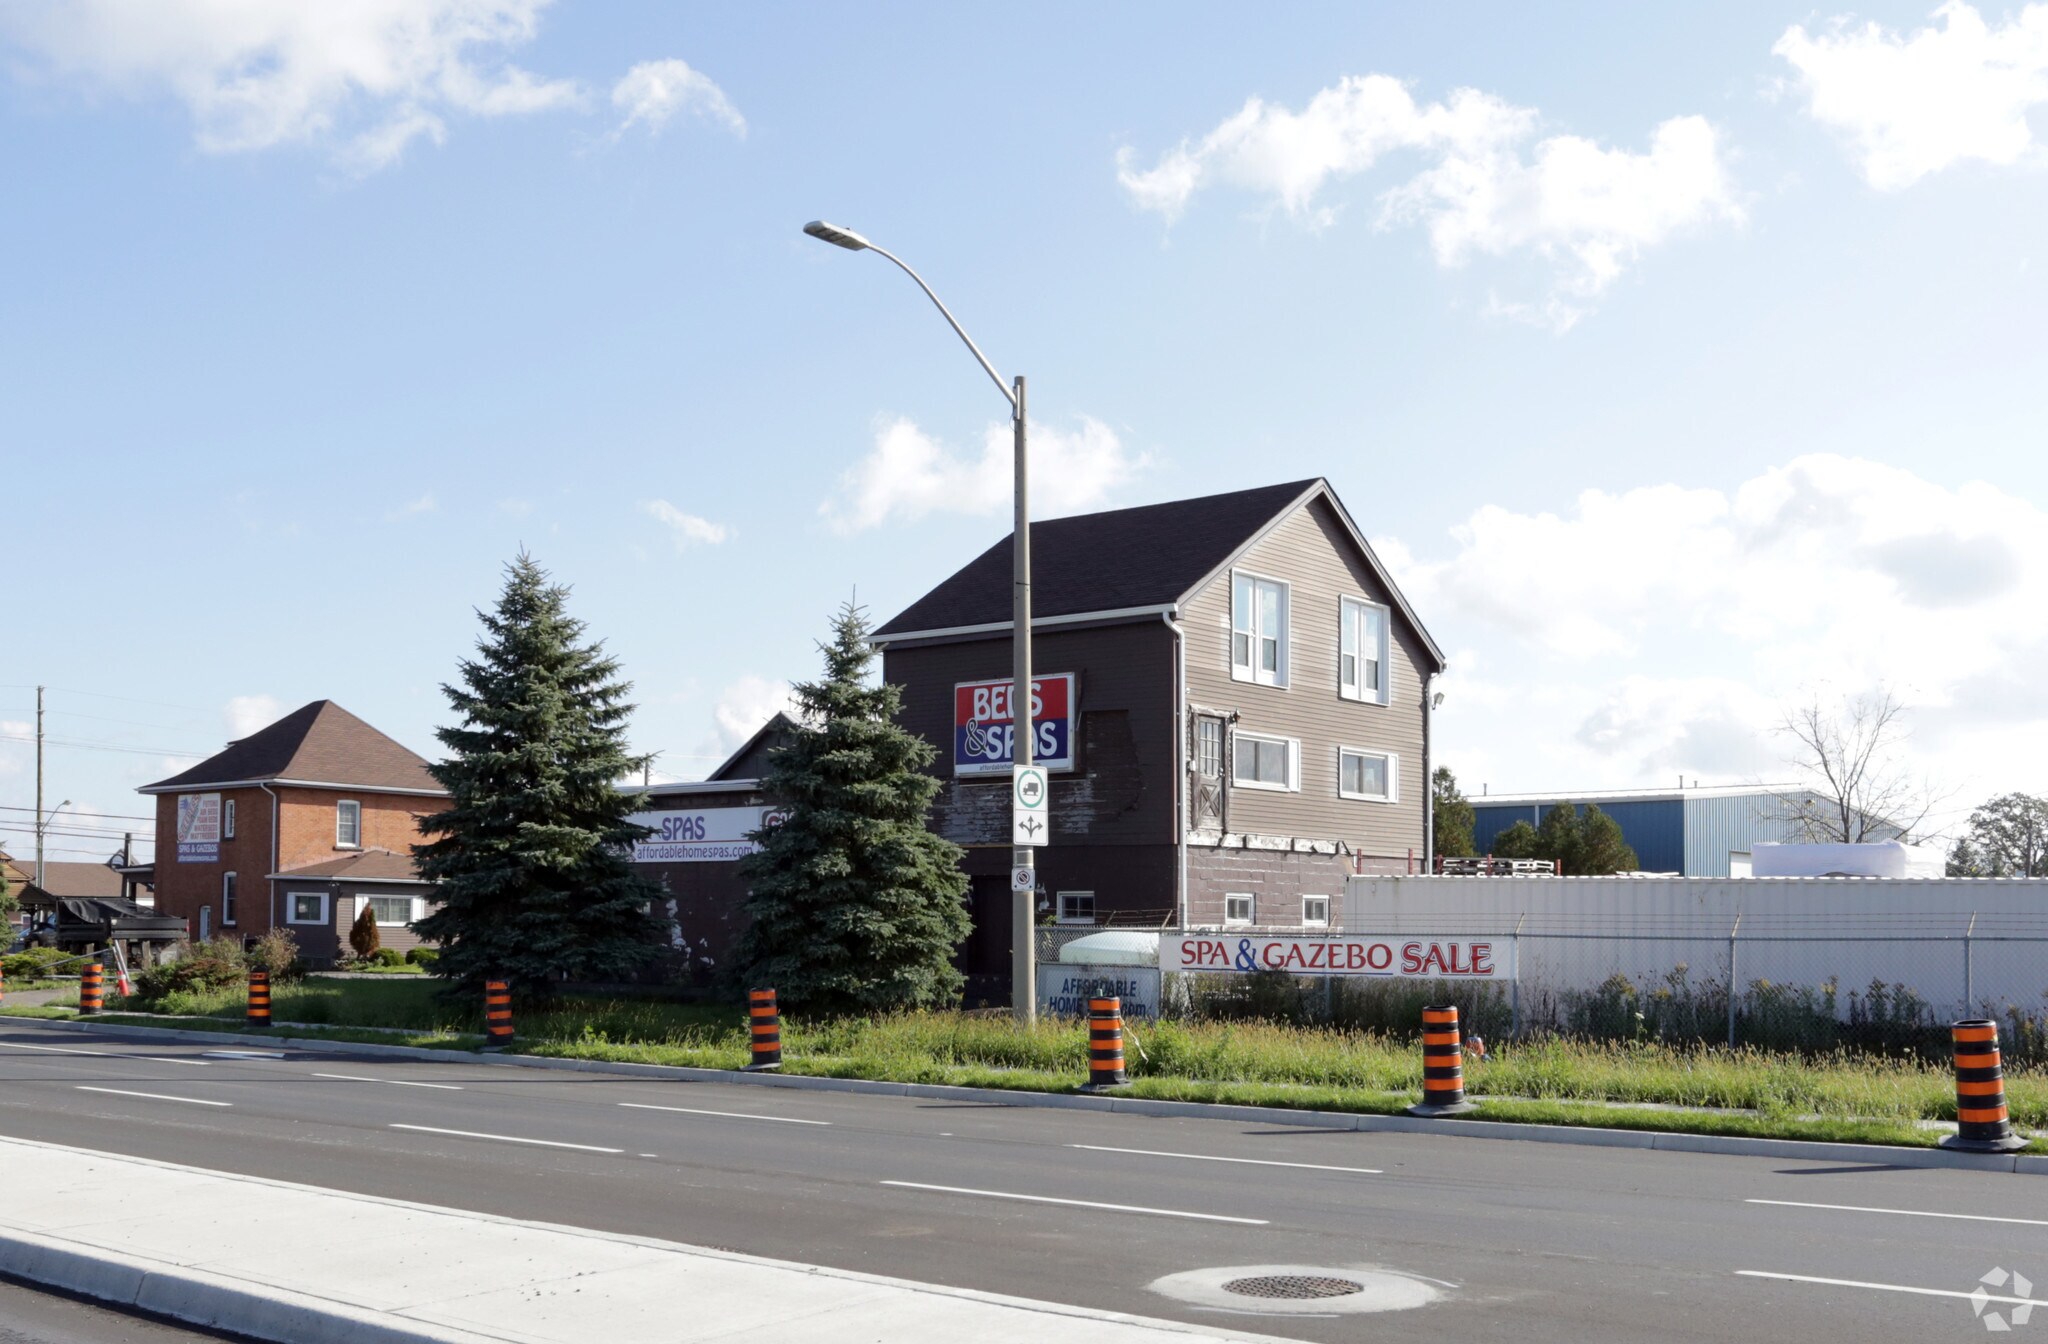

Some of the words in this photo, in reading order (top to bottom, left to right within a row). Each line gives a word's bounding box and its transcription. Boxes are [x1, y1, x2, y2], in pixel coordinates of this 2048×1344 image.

[662, 816, 706, 841] SPAS
[637, 846, 753, 860] affordablehomespas.com
[1181, 940, 1230, 966] SPA
[1235, 938, 1259, 972] &
[1262, 942, 1393, 970] GAZEBO
[1401, 941, 1495, 976] SALE
[1061, 978, 1137, 998] AFFORDABLE
